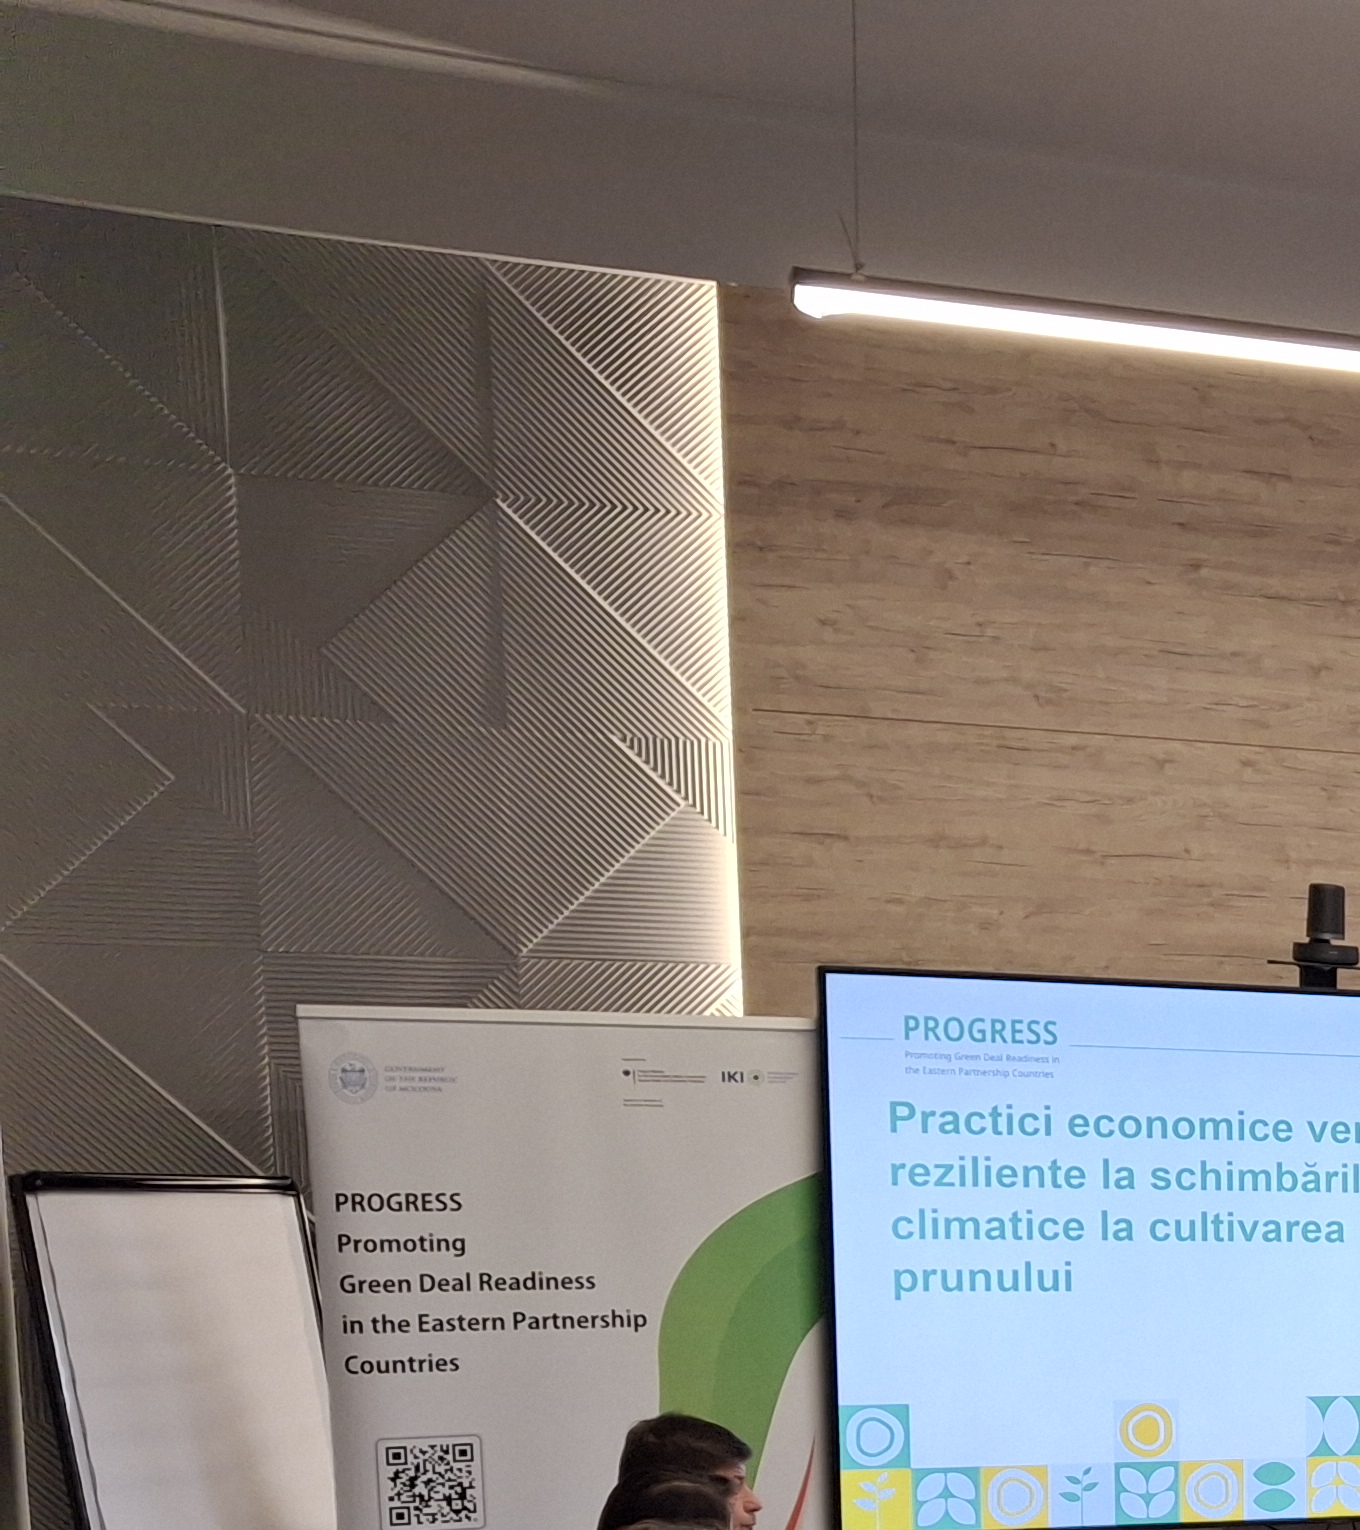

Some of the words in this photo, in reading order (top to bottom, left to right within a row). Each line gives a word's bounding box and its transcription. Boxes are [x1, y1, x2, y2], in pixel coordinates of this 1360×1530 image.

[904, 1015, 1058, 1046] PROGRESS
[954, 1052, 981, 1062] Green
[984, 1053, 1003, 1062] Deal
[1005, 1053, 1049, 1064] Readiness
[721, 1070, 744, 1084] IKI
[959, 1067, 1010, 1079] Partnership
[1012, 1068, 1054, 1079] Countries
[889, 1101, 1053, 1137] Practici
[1068, 1110, 1293, 1143] economice
[890, 1155, 1086, 1190] reziliente
[1102, 1158, 1136, 1190] la
[335, 1192, 463, 1213] PROGRESS
[891, 1208, 1085, 1242] climatice
[1101, 1210, 1134, 1242] la
[1149, 1211, 1345, 1244] cultivarea
[337, 1233, 466, 1257] Promoting
[340, 1273, 412, 1294] Green
[419, 1271, 471, 1293] Deal
[479, 1271, 596, 1292] Readiness
[893, 1260, 1073, 1301] prunului
[342, 1314, 364, 1335] in
[371, 1313, 411, 1334] the
[418, 1311, 506, 1333] Eastern
[512, 1308, 648, 1334] Partnership
[344, 1353, 460, 1376] Countries
